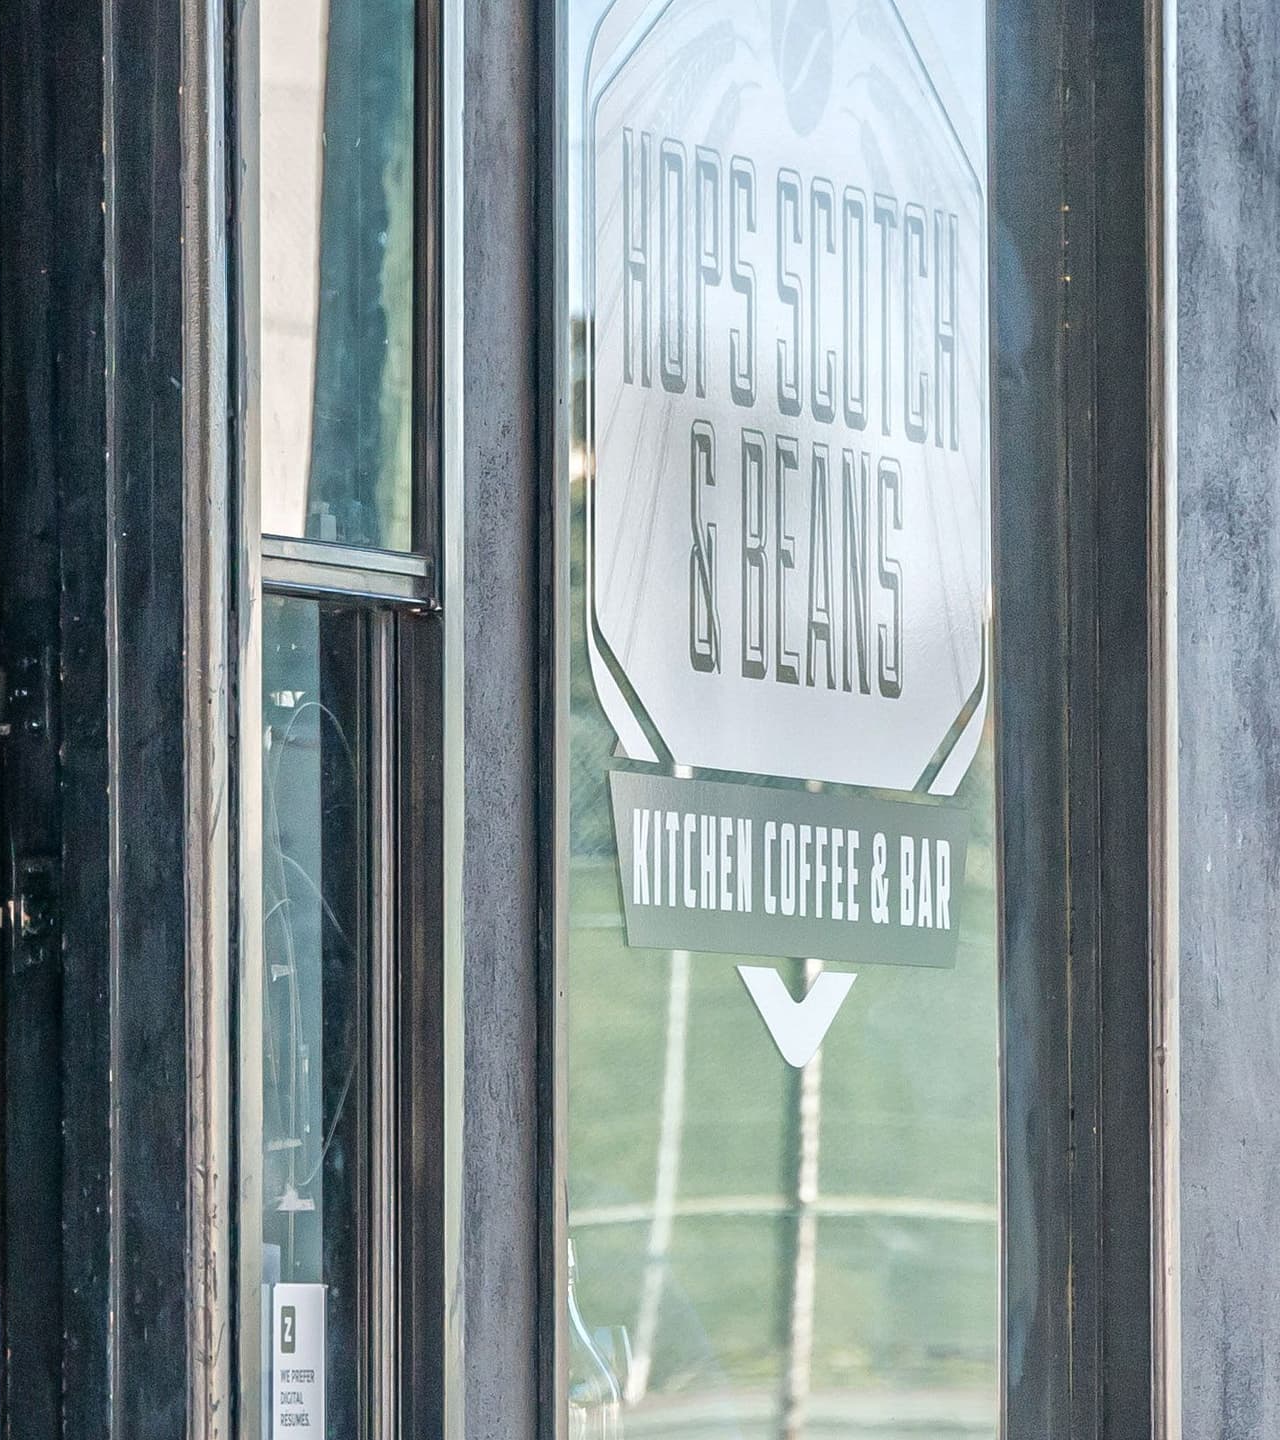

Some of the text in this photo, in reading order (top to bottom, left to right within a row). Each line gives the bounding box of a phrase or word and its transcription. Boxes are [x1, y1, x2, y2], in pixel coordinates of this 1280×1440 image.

[622, 128, 960, 452] HOPS SCOTCH
[688, 420, 904, 700] & BEANS
[632, 807, 951, 931] KITCHEN COFFEE & BAR
[280, 1391, 304, 1405] DIGITAL
[291, 1369, 315, 1384] PREFER
